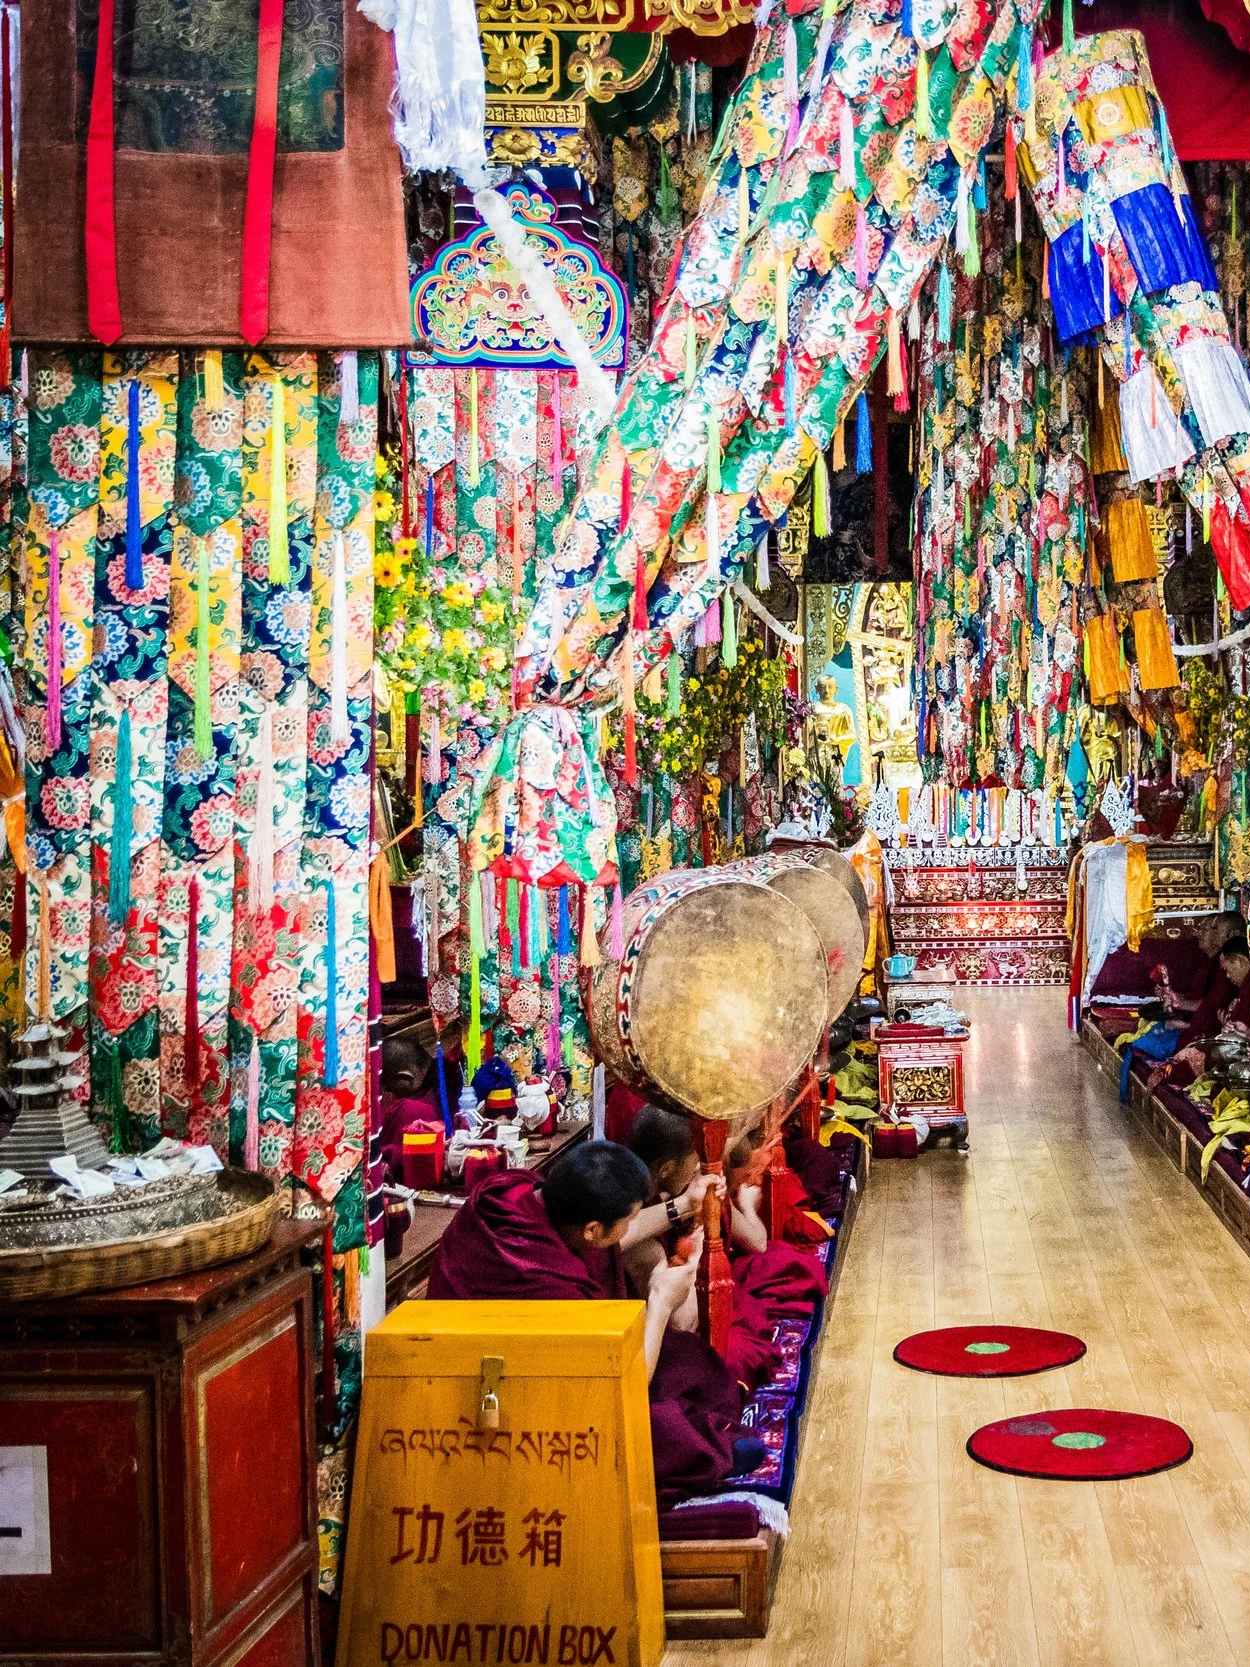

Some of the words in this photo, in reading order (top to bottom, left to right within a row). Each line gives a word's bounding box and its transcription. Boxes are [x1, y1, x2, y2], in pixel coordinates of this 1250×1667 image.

[389, 1504, 567, 1567] 功德箱
[380, 1622, 550, 1664] DONATION
[557, 1624, 617, 1666] BOX
